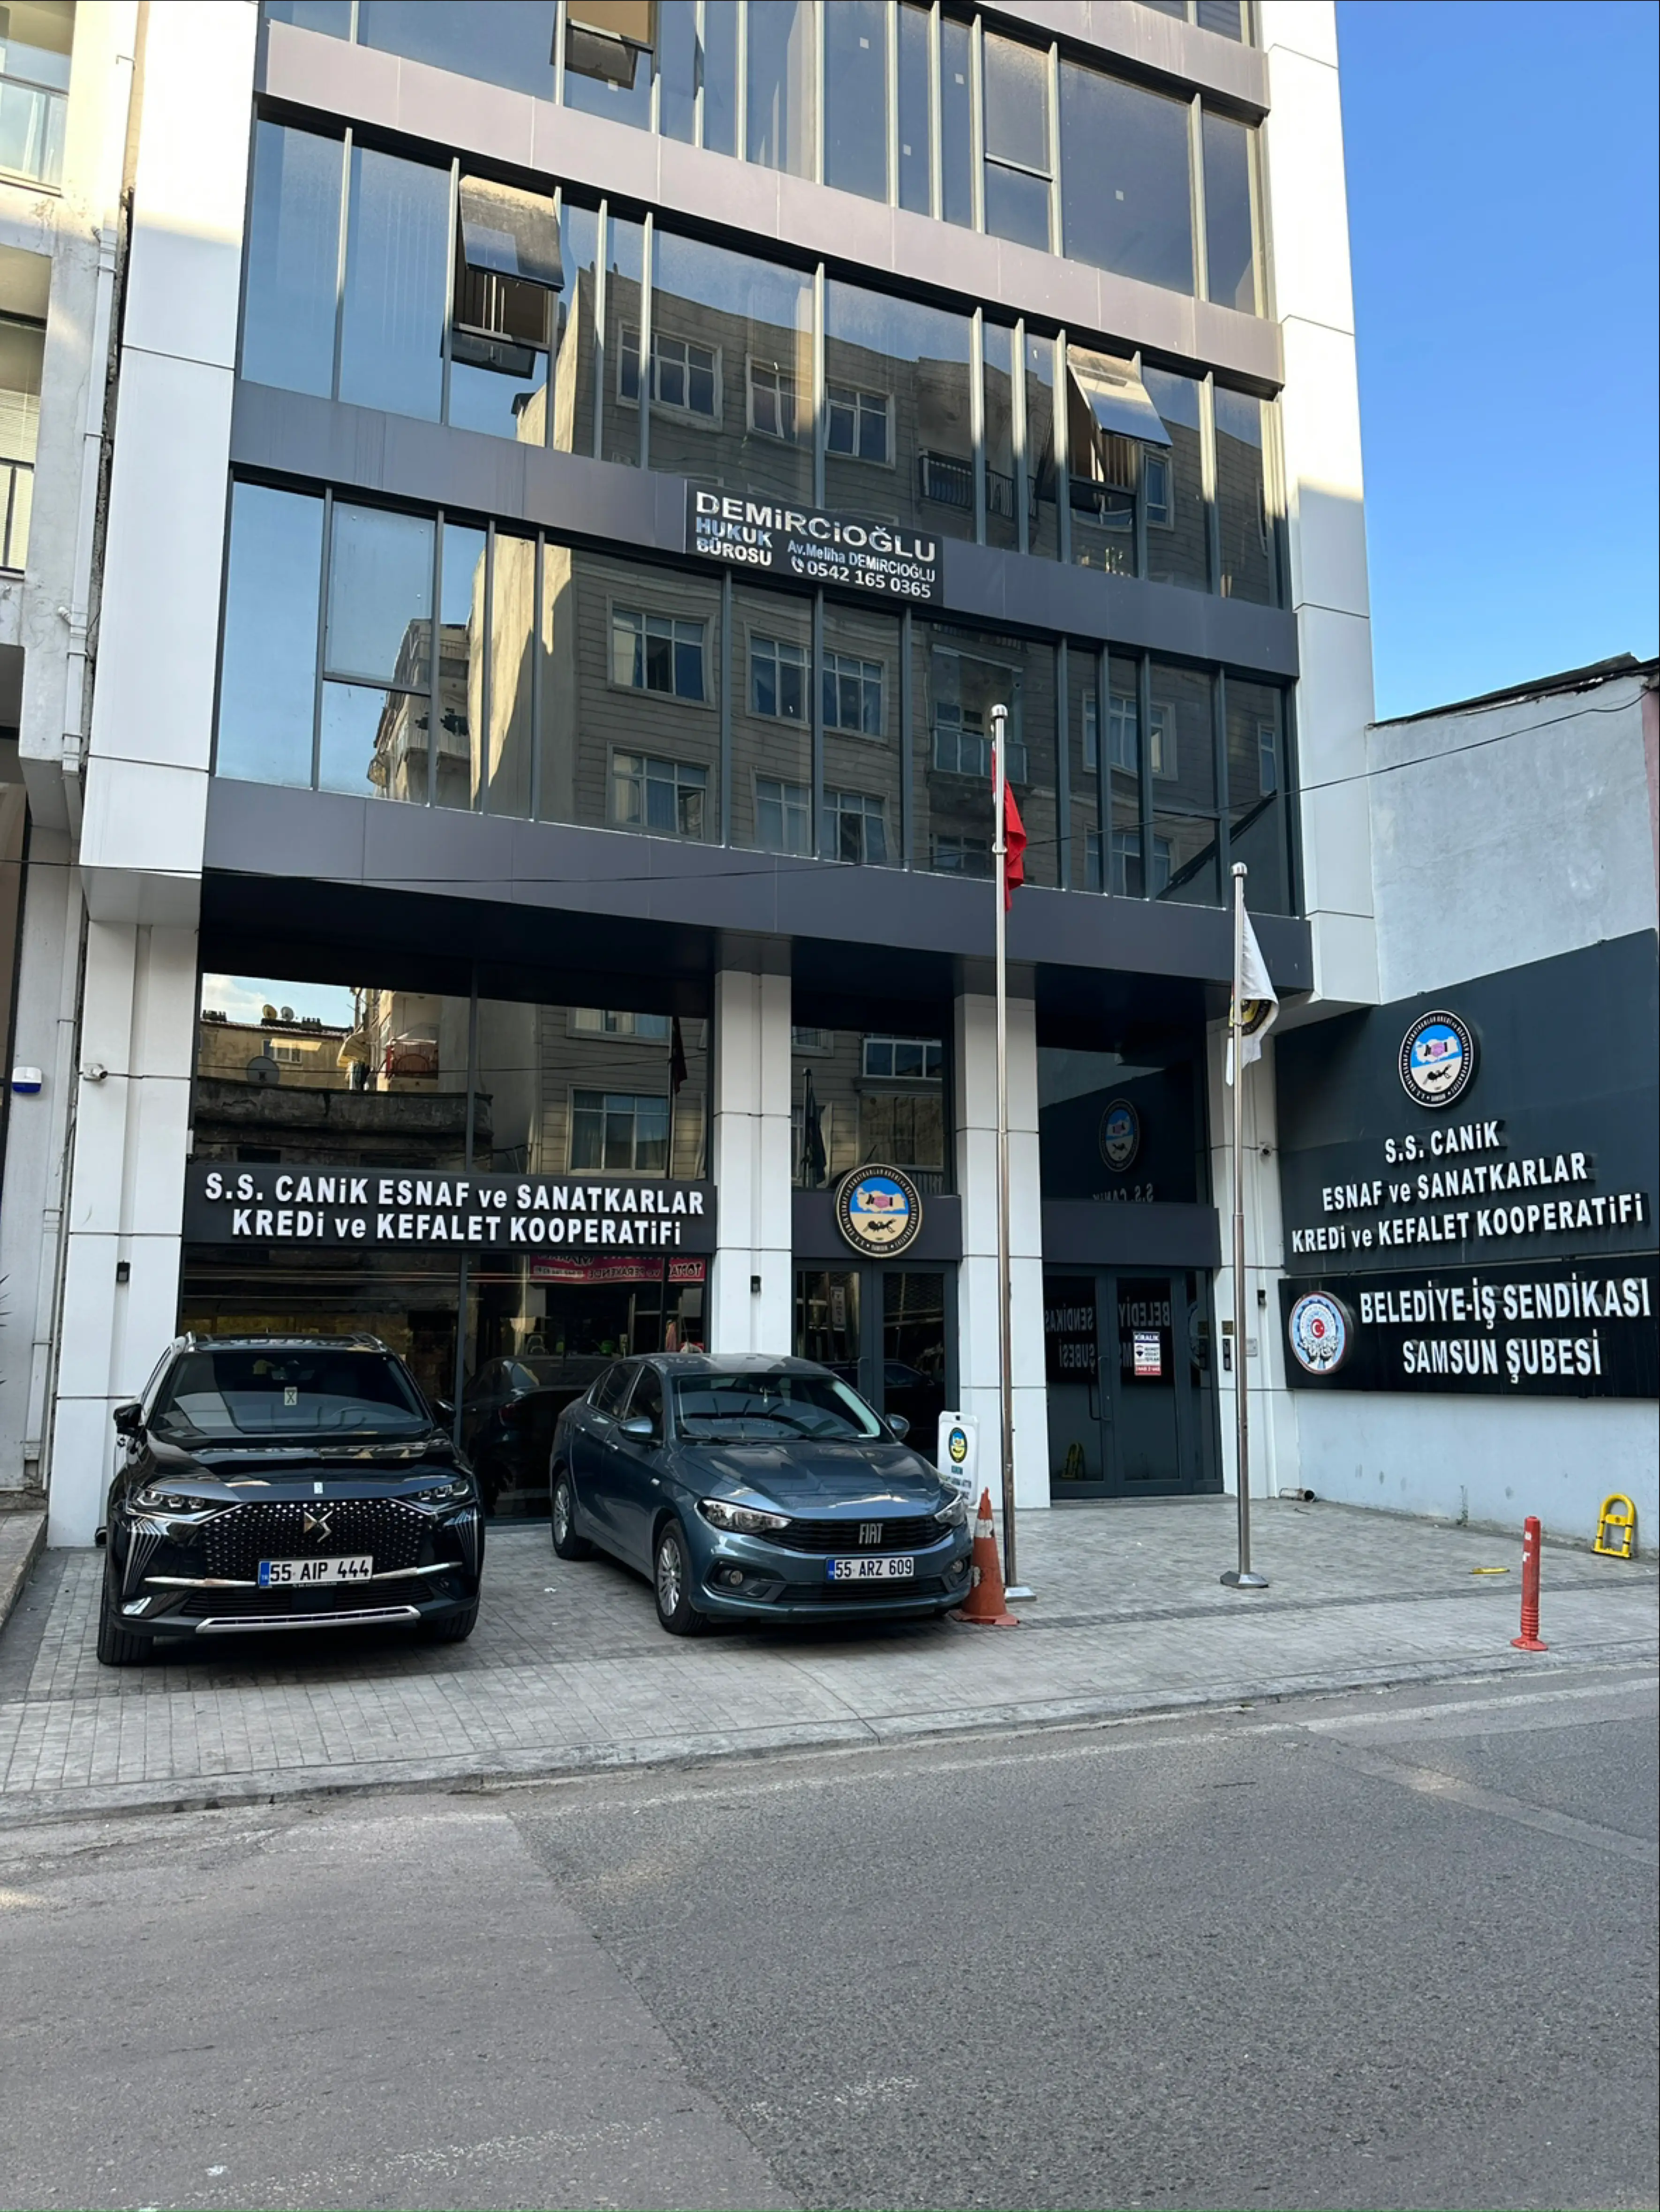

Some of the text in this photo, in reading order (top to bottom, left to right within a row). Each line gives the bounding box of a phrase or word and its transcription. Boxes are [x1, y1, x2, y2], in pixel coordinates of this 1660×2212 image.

[695, 517, 773, 548] HUKUK
[696, 537, 772, 566] BÜROSU
[787, 539, 845, 564] Av.Meliha
[807, 560, 931, 598] 0542 165 0365
[1385, 1135, 1425, 1164] S.S.
[205, 1172, 263, 1201] S.S.
[378, 1179, 469, 1206] ESNAF
[478, 1186, 507, 1209] ve
[516, 1184, 704, 1215] SANATKARLAR
[1323, 1151, 1587, 1212] ESNAF ve SANATKARLAR
[334, 1216, 366, 1238] ve
[377, 1212, 500, 1241] KEFALET
[1352, 1232, 1372, 1248] ve
[1379, 1212, 1469, 1246] KEFALET
[1360, 1277, 1495, 1329] BELEDİYE-İŞ
[1503, 1273, 1651, 1321] SENDİKASI
[1403, 1329, 1601, 1384] SAMSUN ŞUBESİ
[859, 1523, 883, 1545] FIAT
[271, 1563, 292, 1582] 55
[300, 1562, 328, 1580] AIP
[338, 1560, 370, 1578] 444
[836, 1559, 911, 1577] 55 ARZ 609
